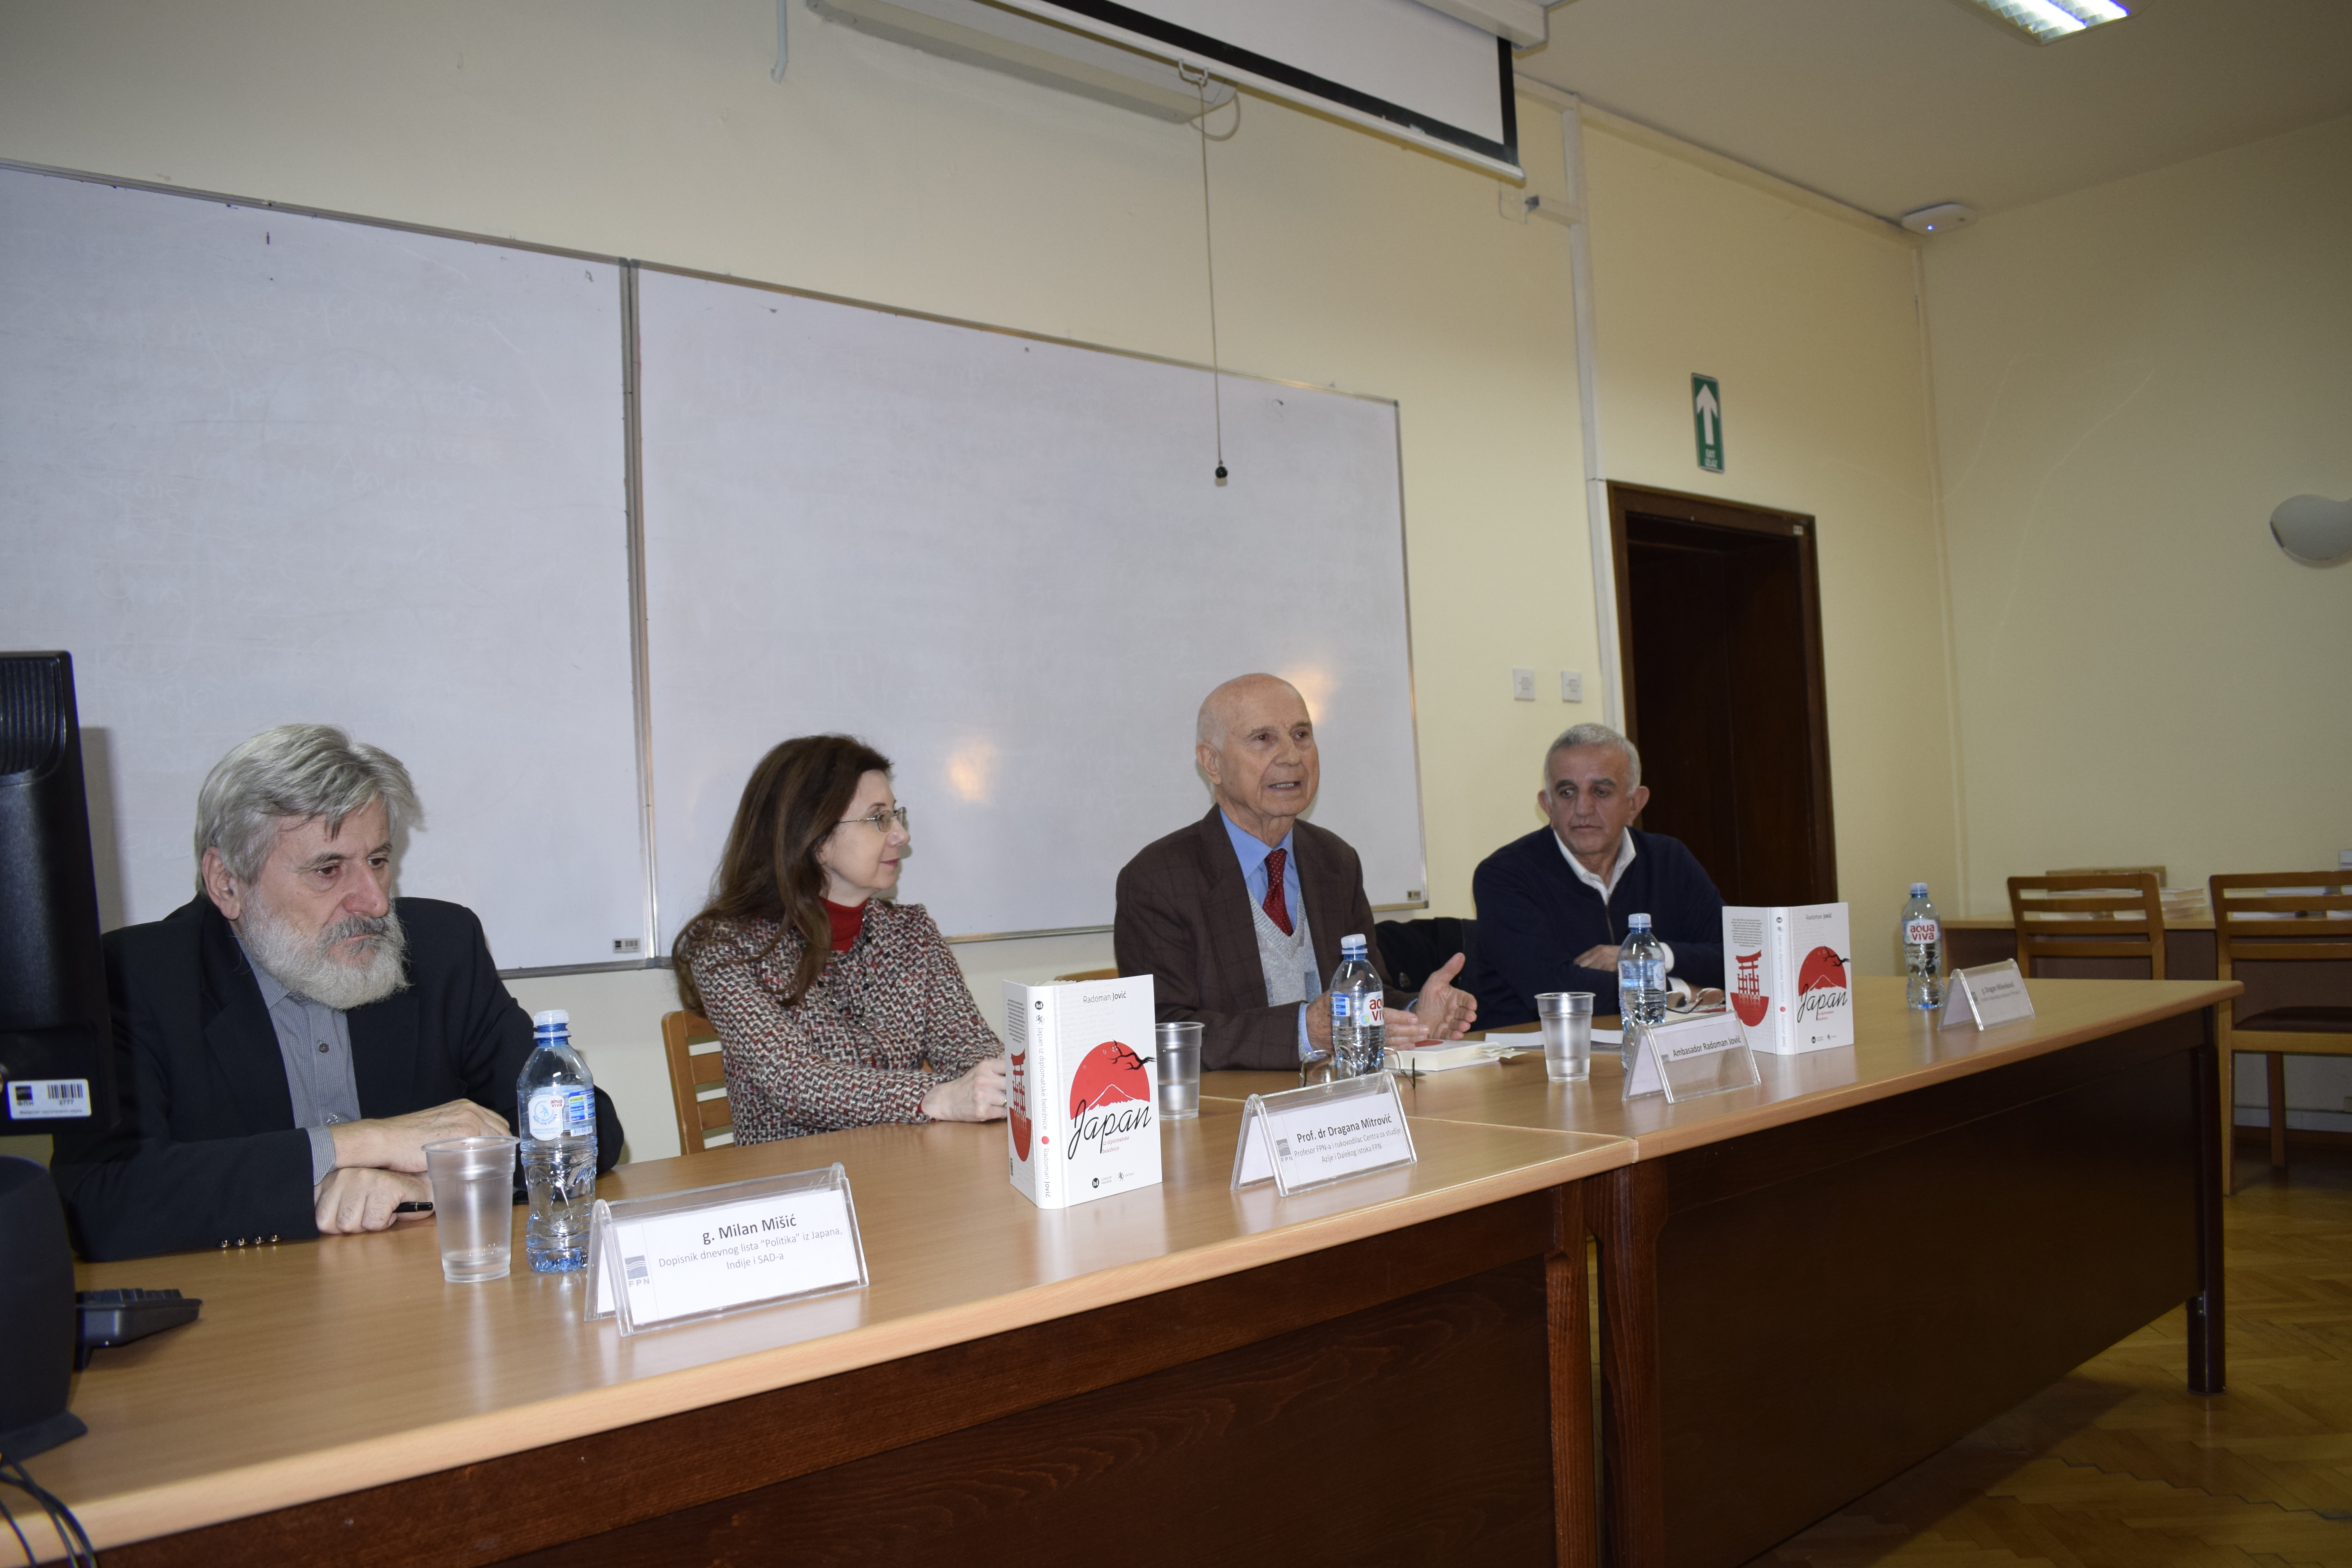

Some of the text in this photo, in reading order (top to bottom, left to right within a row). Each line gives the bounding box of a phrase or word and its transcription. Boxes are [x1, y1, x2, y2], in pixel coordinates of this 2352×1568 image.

[1912, 932, 1935, 940] viva
[1083, 990, 1127, 1004] Radoman Jović
[1797, 984, 1847, 1023] Japan
[1673, 1035, 1741, 1057] Ambasador Radoman Jović
[1038, 1055, 1047, 1097] diplomatske
[1068, 1099, 1152, 1160] Japan
[1107, 1135, 1129, 1145] diplomatske
[1297, 1113, 1392, 1143] Prof. dr Dragana Mitrović
[1294, 1146, 1316, 1158] Profesor
[1316, 1144, 1332, 1153] FPN-a
[1335, 1136, 1363, 1149] rukovodilac
[1363, 1133, 1379, 1142] Centra
[1385, 1127, 1401, 1138] studije
[1322, 1154, 1334, 1164] Azije
[1338, 1149, 1357, 1160] Dalekog
[1357, 1145, 1372, 1155] istoka
[1372, 1143, 1382, 1152] FPN
[702, 1214, 797, 1245] g. Milan Mišić
[659, 1252, 699, 1268] Dopisnik
[701, 1245, 739, 1261] dnevnog
[741, 1242, 759, 1254] lista
[802, 1232, 810, 1241] iz
[812, 1227, 843, 1240] Japana,
[727, 1257, 751, 1270] Indije
[758, 1252, 784, 1265] SAD-a
[628, 1277, 650, 1288] FPN
